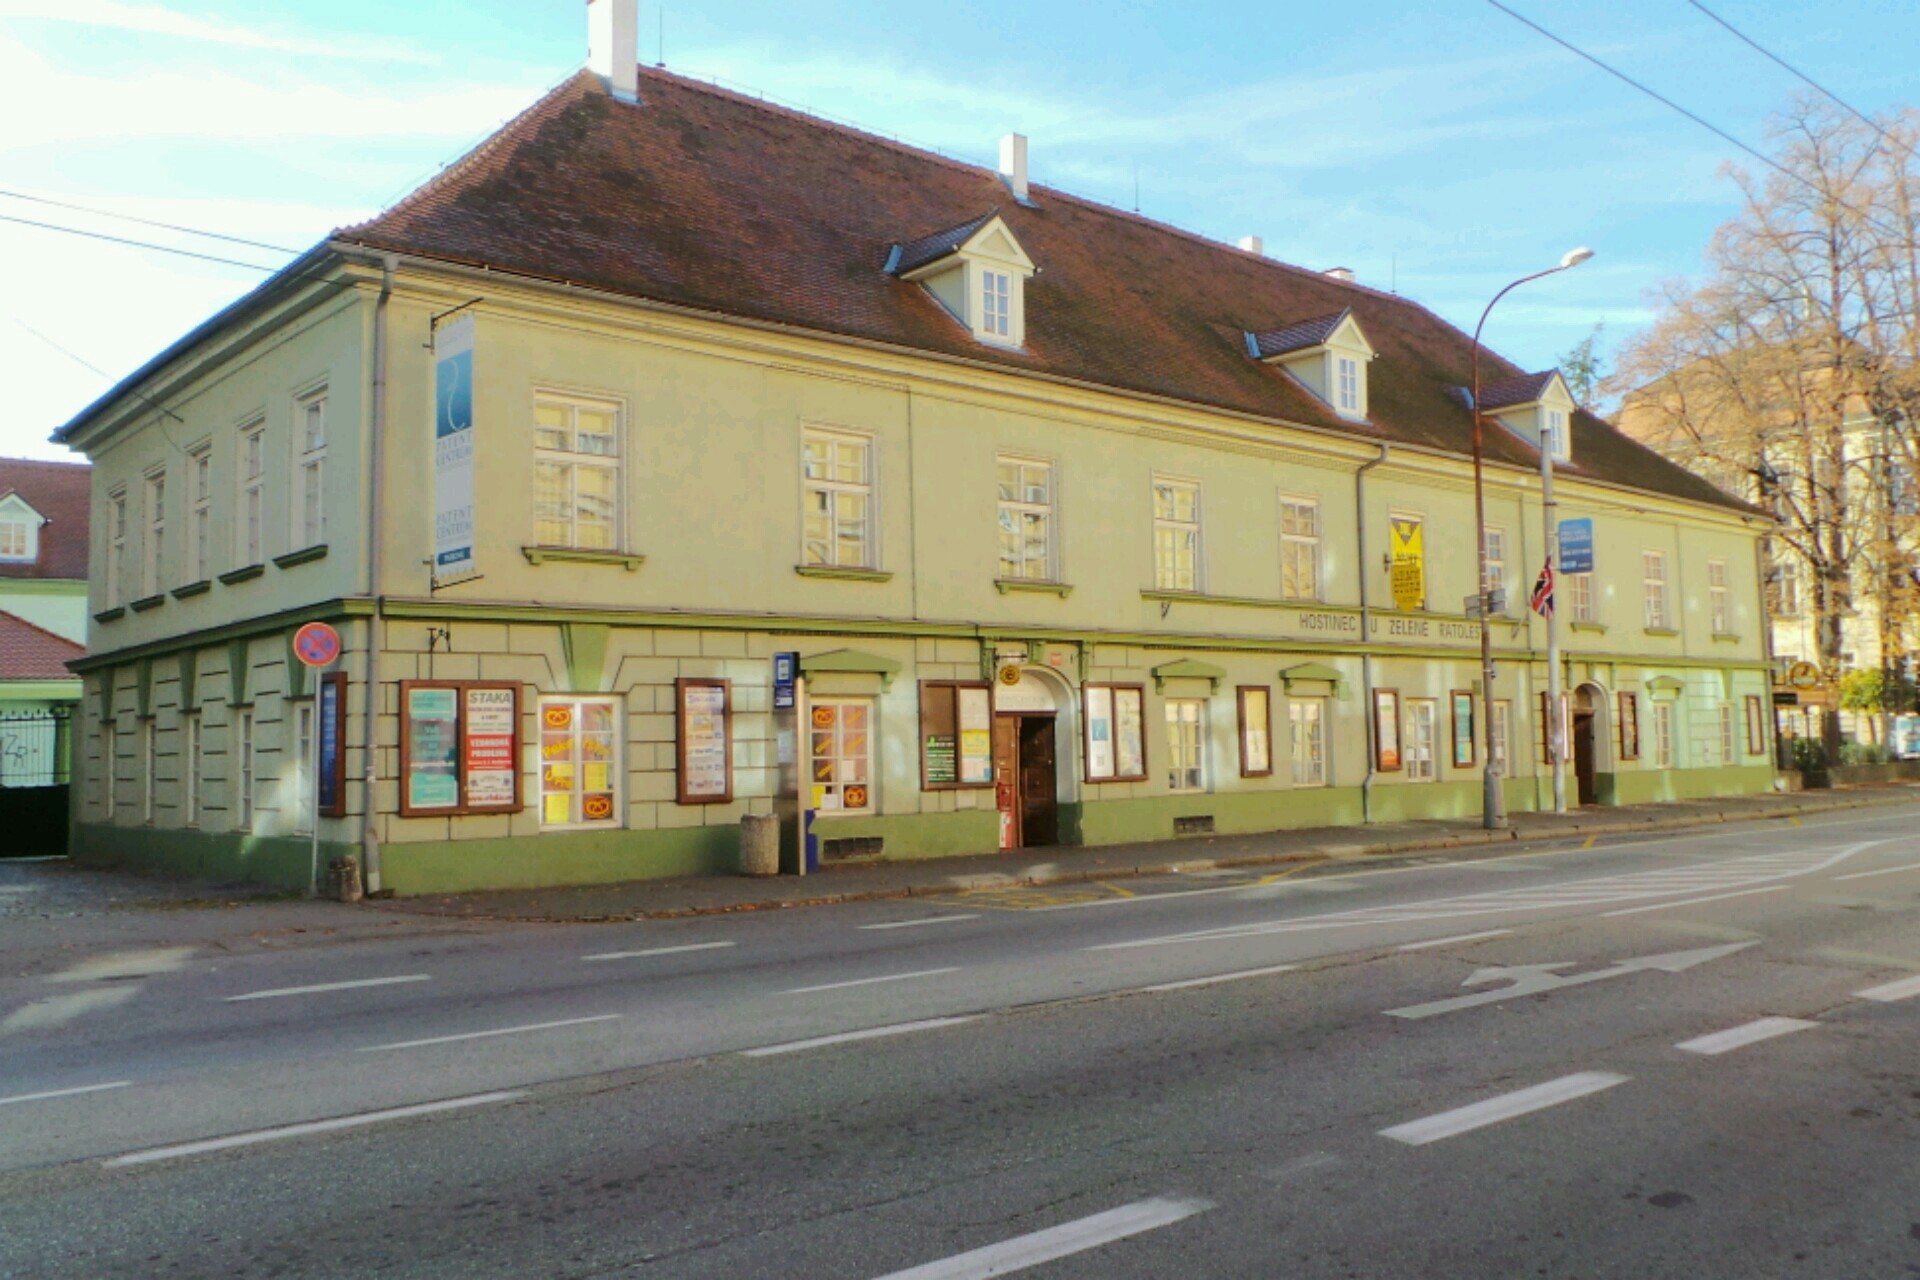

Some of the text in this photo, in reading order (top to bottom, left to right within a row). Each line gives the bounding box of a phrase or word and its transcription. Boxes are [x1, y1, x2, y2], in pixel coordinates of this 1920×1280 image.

[1299, 613, 1356, 632] HOSTINEC
[1370, 617, 1378, 633] U
[1439, 623, 1482, 640] RATOLES
[470, 692, 511, 704] STAKA
